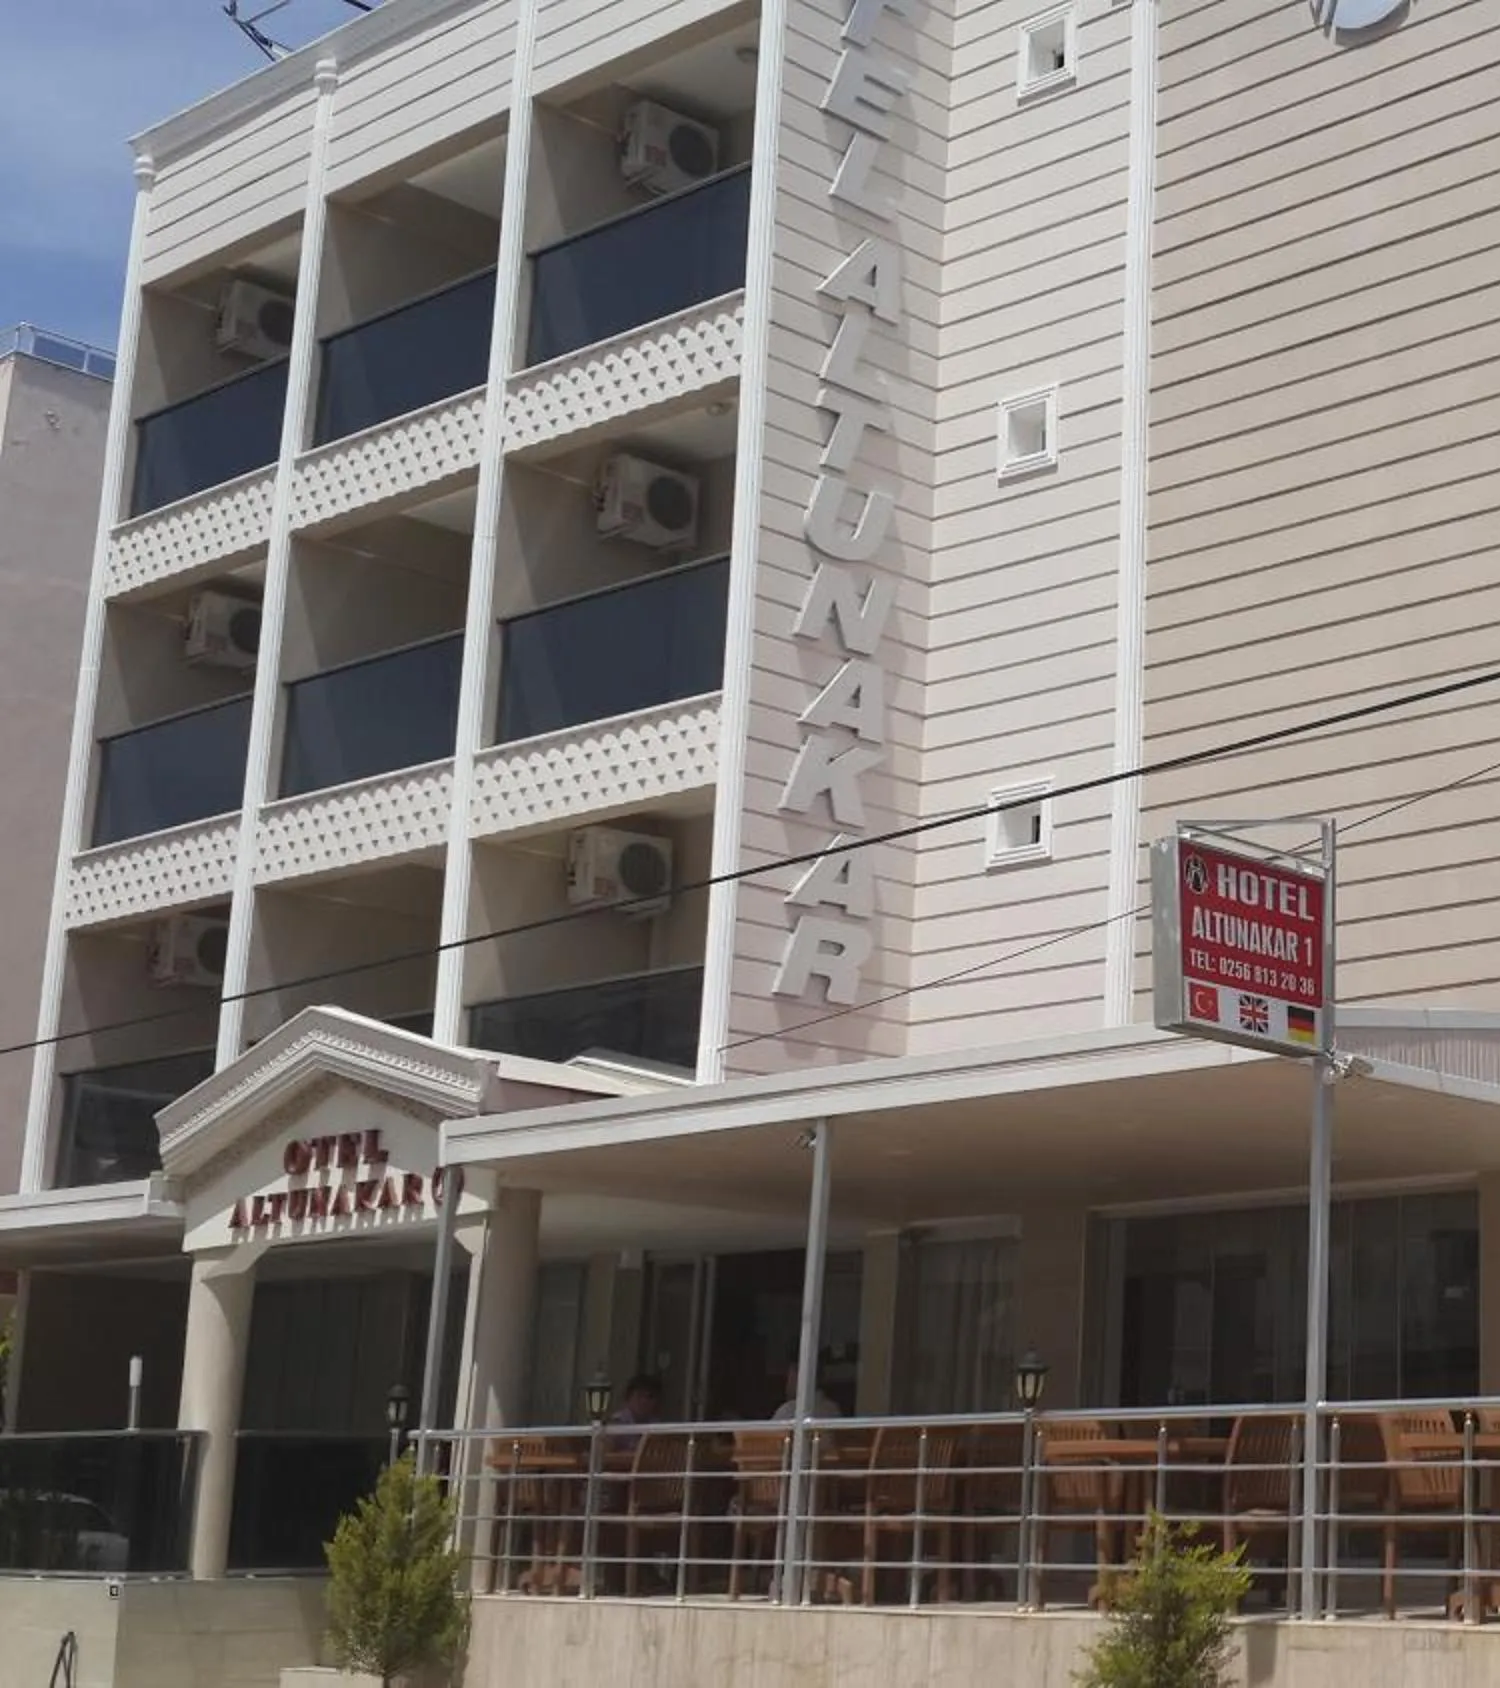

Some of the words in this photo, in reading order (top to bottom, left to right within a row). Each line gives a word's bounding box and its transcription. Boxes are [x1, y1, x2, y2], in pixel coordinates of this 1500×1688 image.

[771, 236, 899, 1005] ALTUNAKAR
[1217, 863, 1315, 922] HOTEL
[1189, 947, 1216, 972] TEL:
[1220, 956, 1251, 980] 0256
[1191, 905, 1298, 964] ALTUNAKAR
[1304, 937, 1313, 967] 1
[284, 1129, 389, 1175] OTEL
[228, 1173, 425, 1228] ALTUNAKAR
